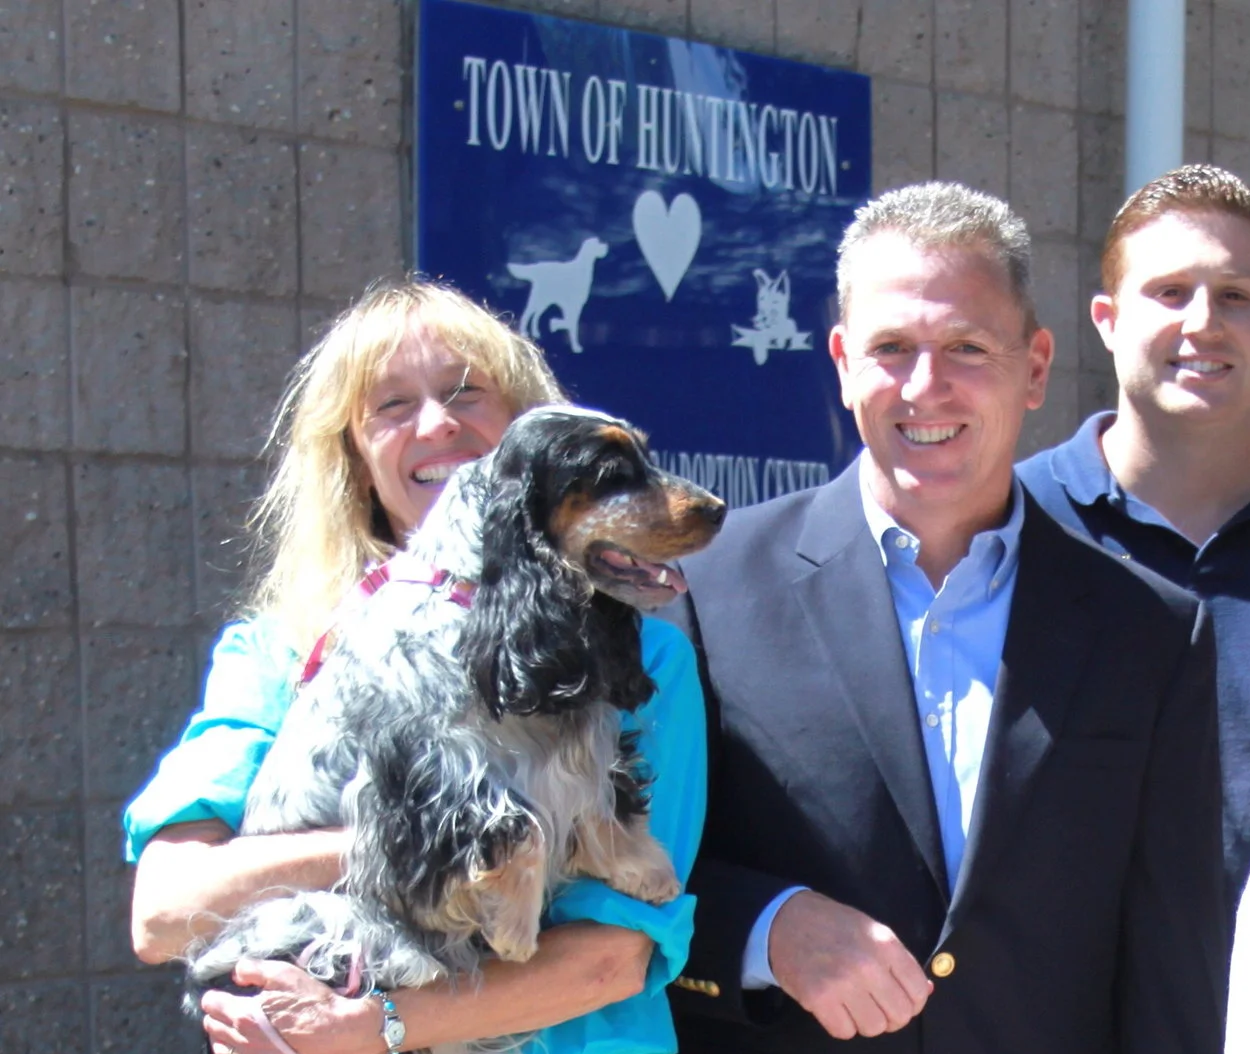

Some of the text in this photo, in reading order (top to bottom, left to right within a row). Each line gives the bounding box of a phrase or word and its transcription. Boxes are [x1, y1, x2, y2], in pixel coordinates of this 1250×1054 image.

[463, 55, 838, 196] TOWN OF HUNTINGTON
